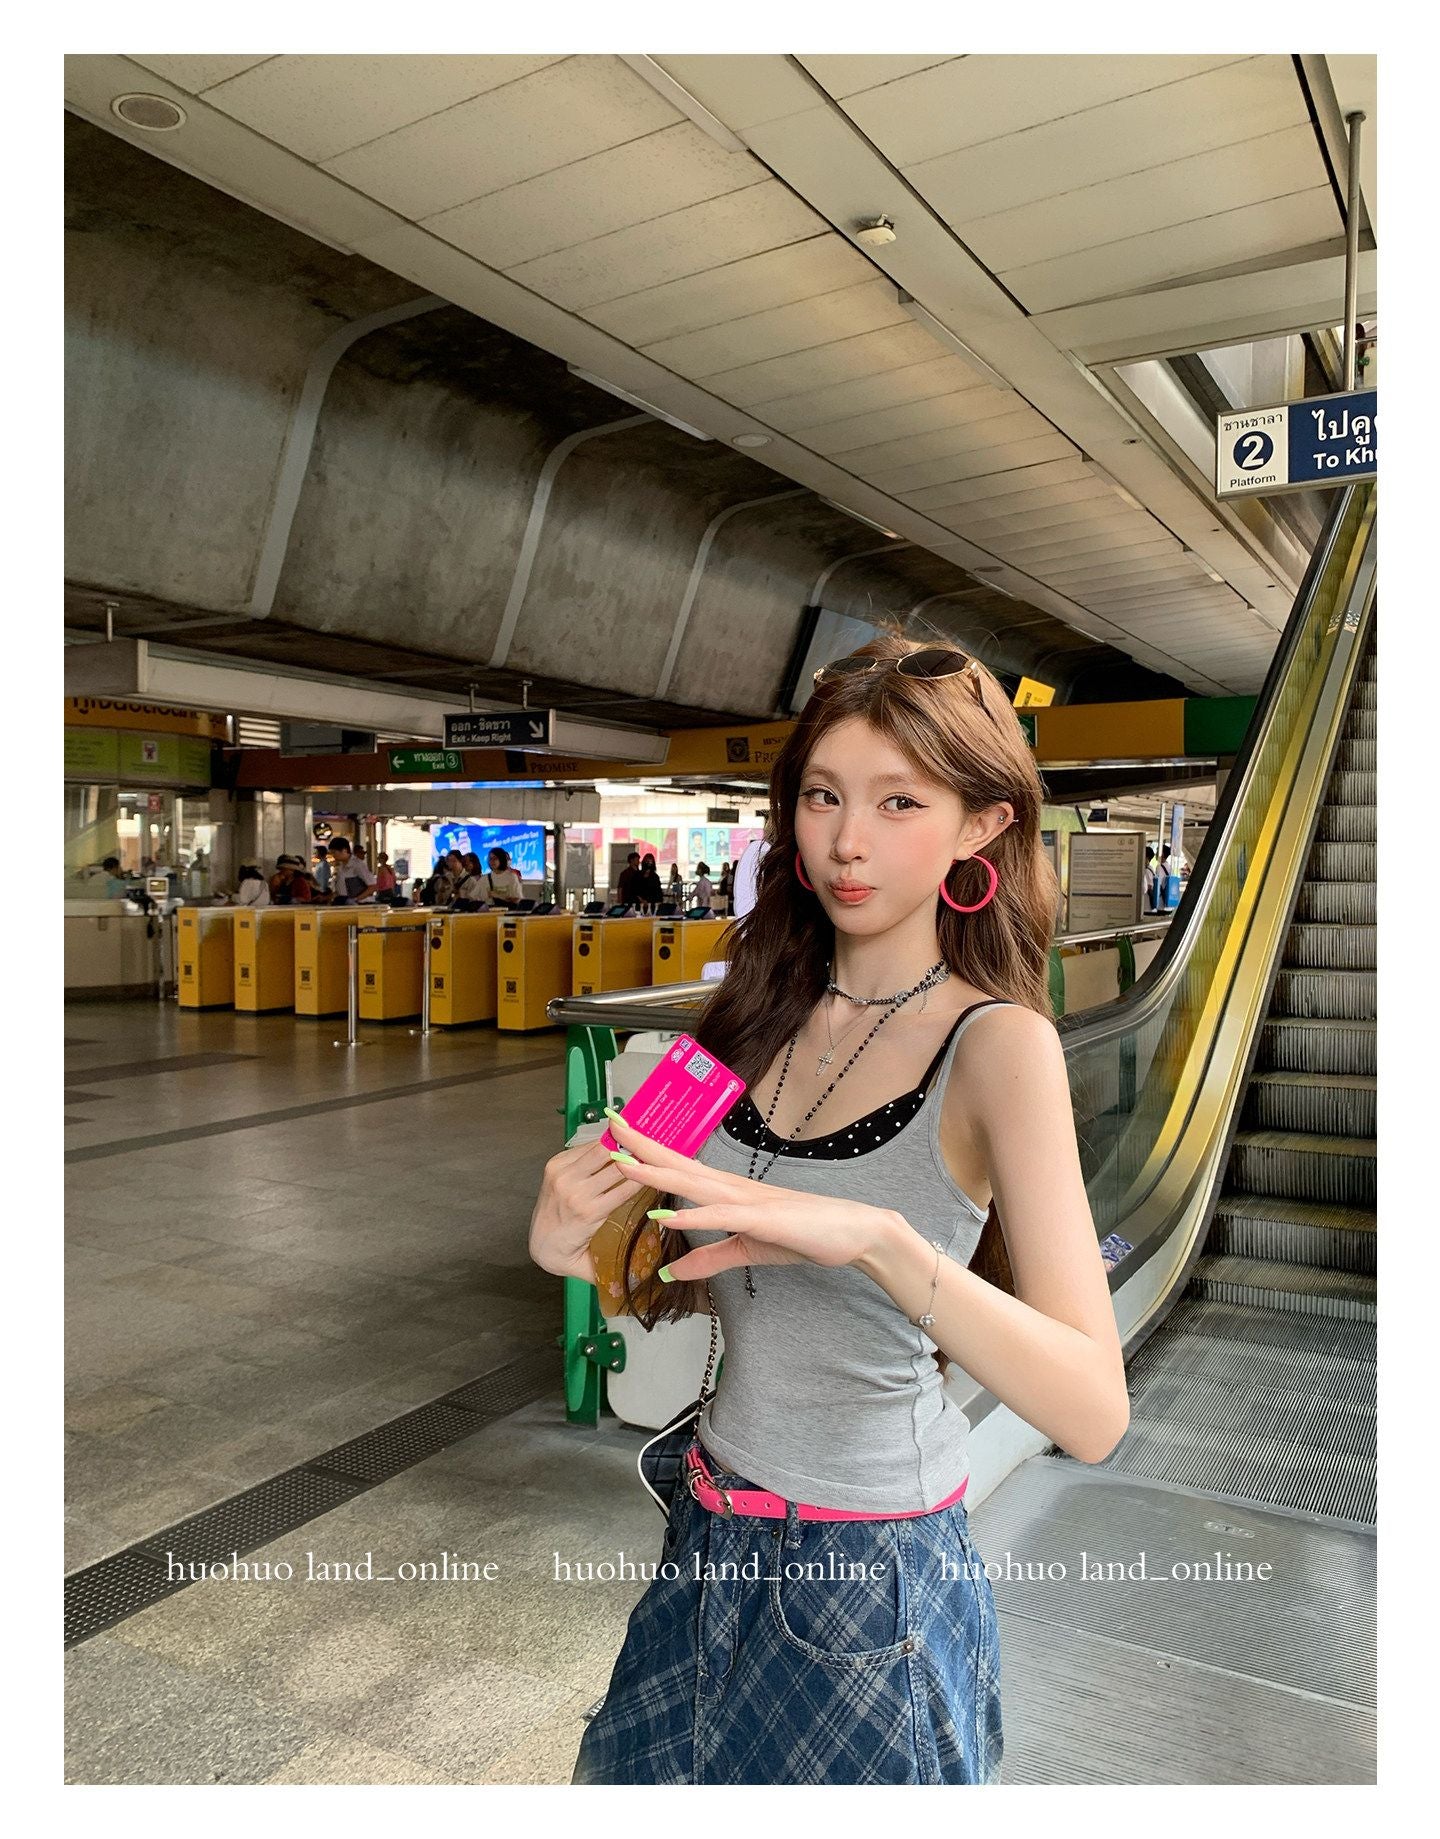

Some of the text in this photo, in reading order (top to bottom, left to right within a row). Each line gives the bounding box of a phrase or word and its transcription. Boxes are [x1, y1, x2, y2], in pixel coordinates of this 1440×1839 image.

[1223, 413, 1284, 431] ชานชาลา
[1242, 435, 1265, 468] 2
[1313, 453, 1340, 470] To
[1230, 474, 1277, 488] Platform
[451, 722, 471, 732] ออก
[451, 734, 466, 744] Exit
[471, 733, 490, 744] Keep
[491, 732, 512, 744] Right
